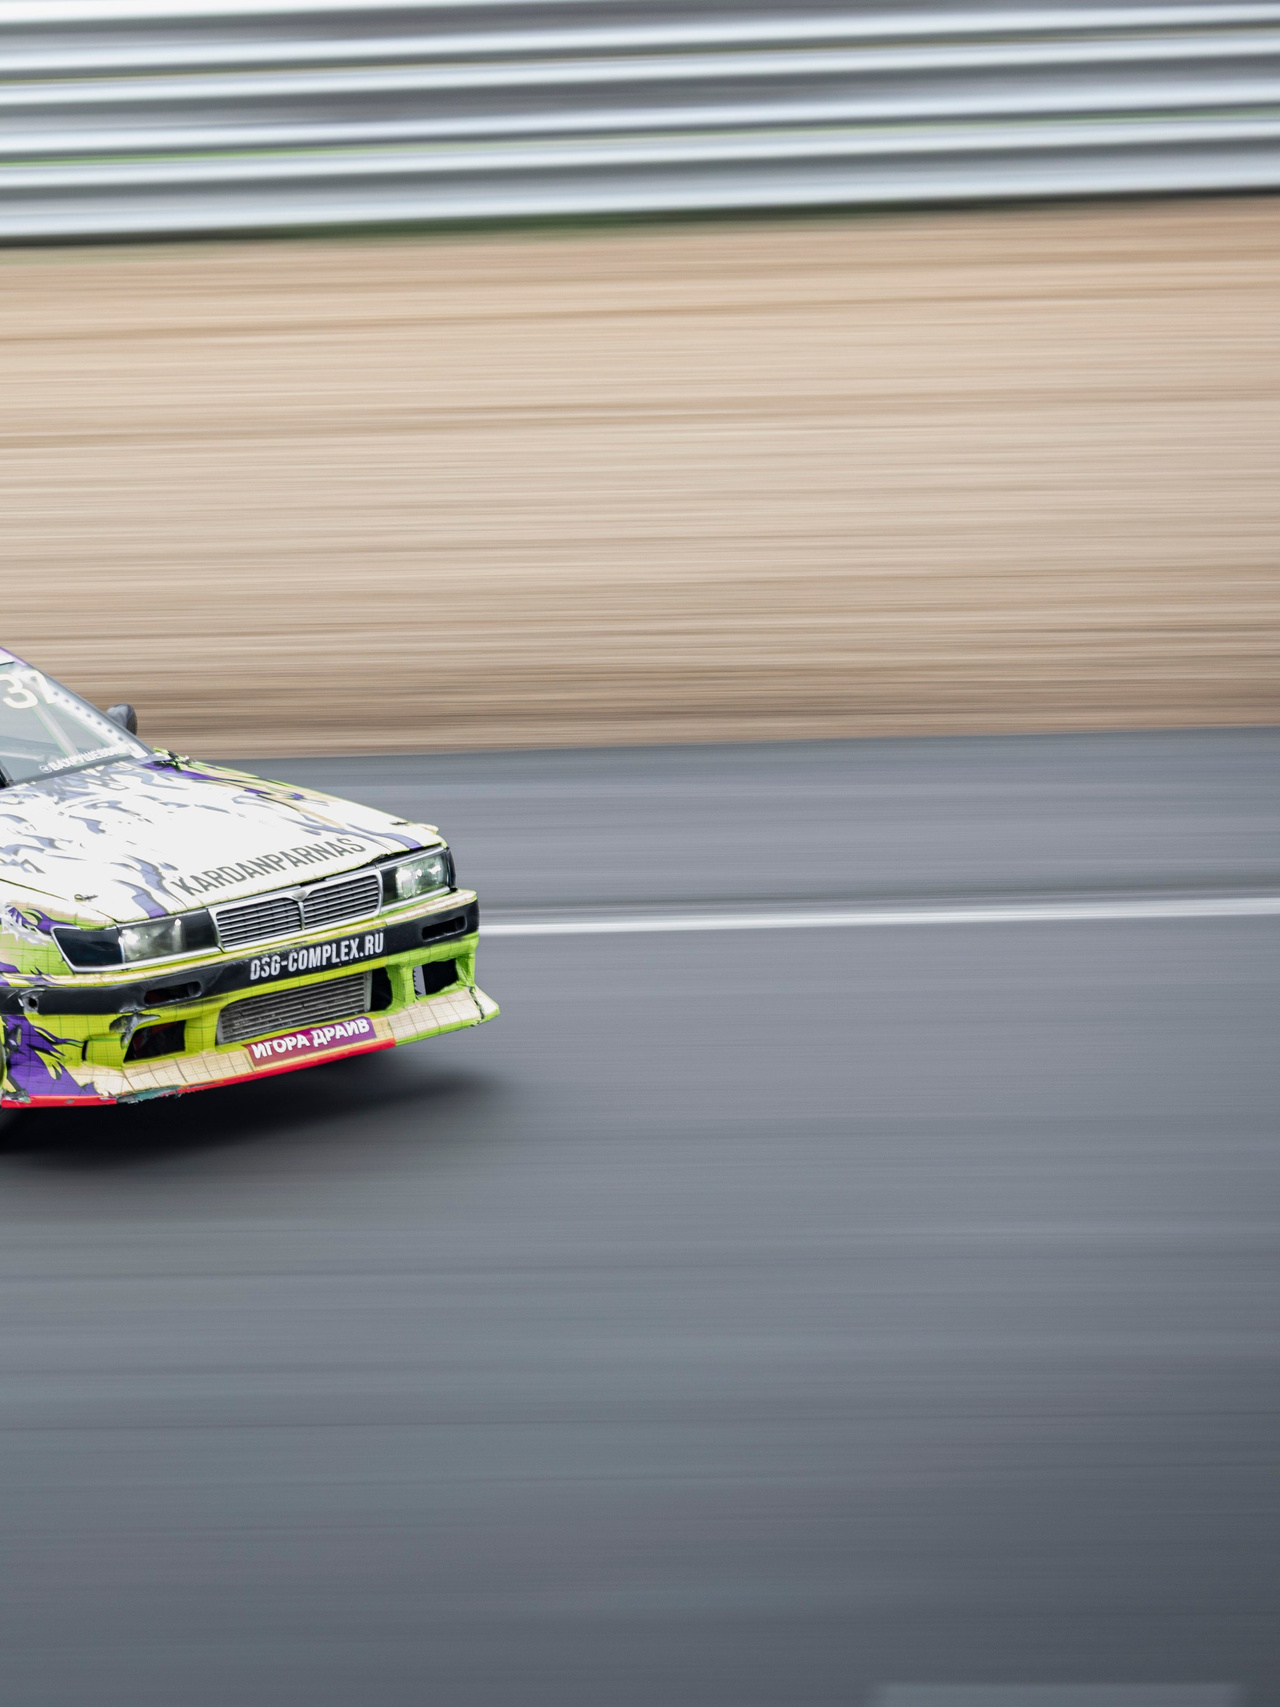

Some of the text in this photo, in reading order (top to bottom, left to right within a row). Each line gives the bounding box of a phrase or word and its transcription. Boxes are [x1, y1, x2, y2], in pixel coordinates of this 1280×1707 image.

[170, 838, 367, 896] KARDANPARNAS
[250, 932, 384, 981] DSG-COMPLEX.RU
[252, 1018, 370, 1059] ИГОРА ДРАЙВ
